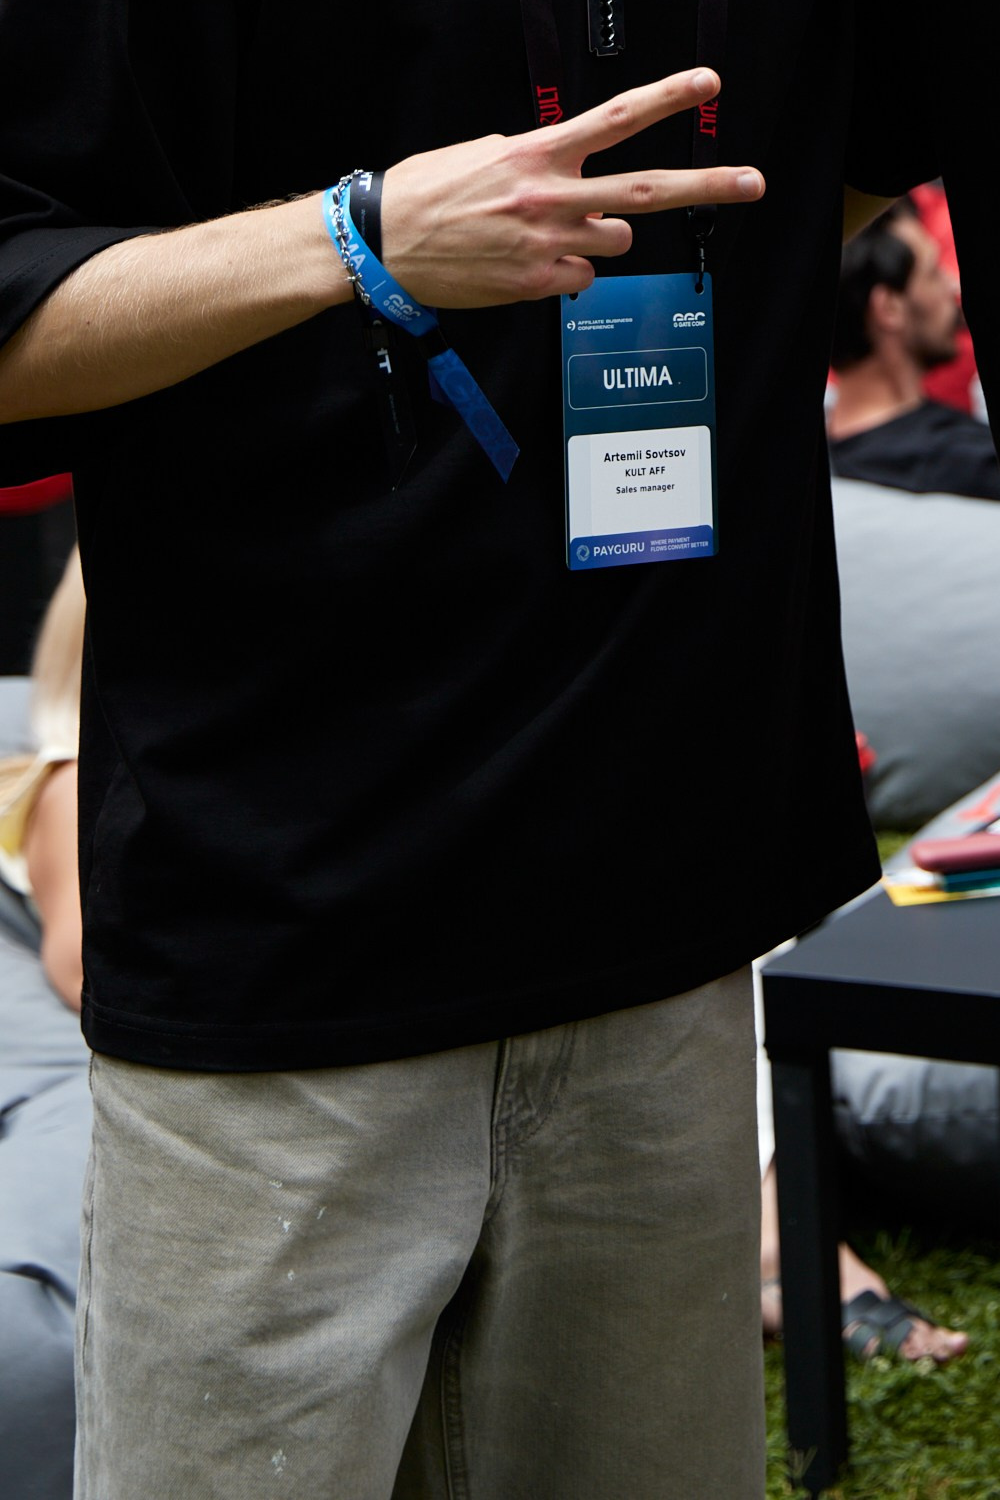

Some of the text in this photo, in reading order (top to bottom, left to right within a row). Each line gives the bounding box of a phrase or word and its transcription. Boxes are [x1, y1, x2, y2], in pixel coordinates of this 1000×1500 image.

[603, 365, 673, 390] ULTIMA
[604, 448, 686, 462] Artemii Sovtsov
[625, 466, 666, 477] KULT AFF
[616, 483, 675, 494] Sales manager
[593, 542, 645, 557] PAYGURU
[667, 543, 691, 551] CONVERT
[690, 541, 709, 549] BETTER
